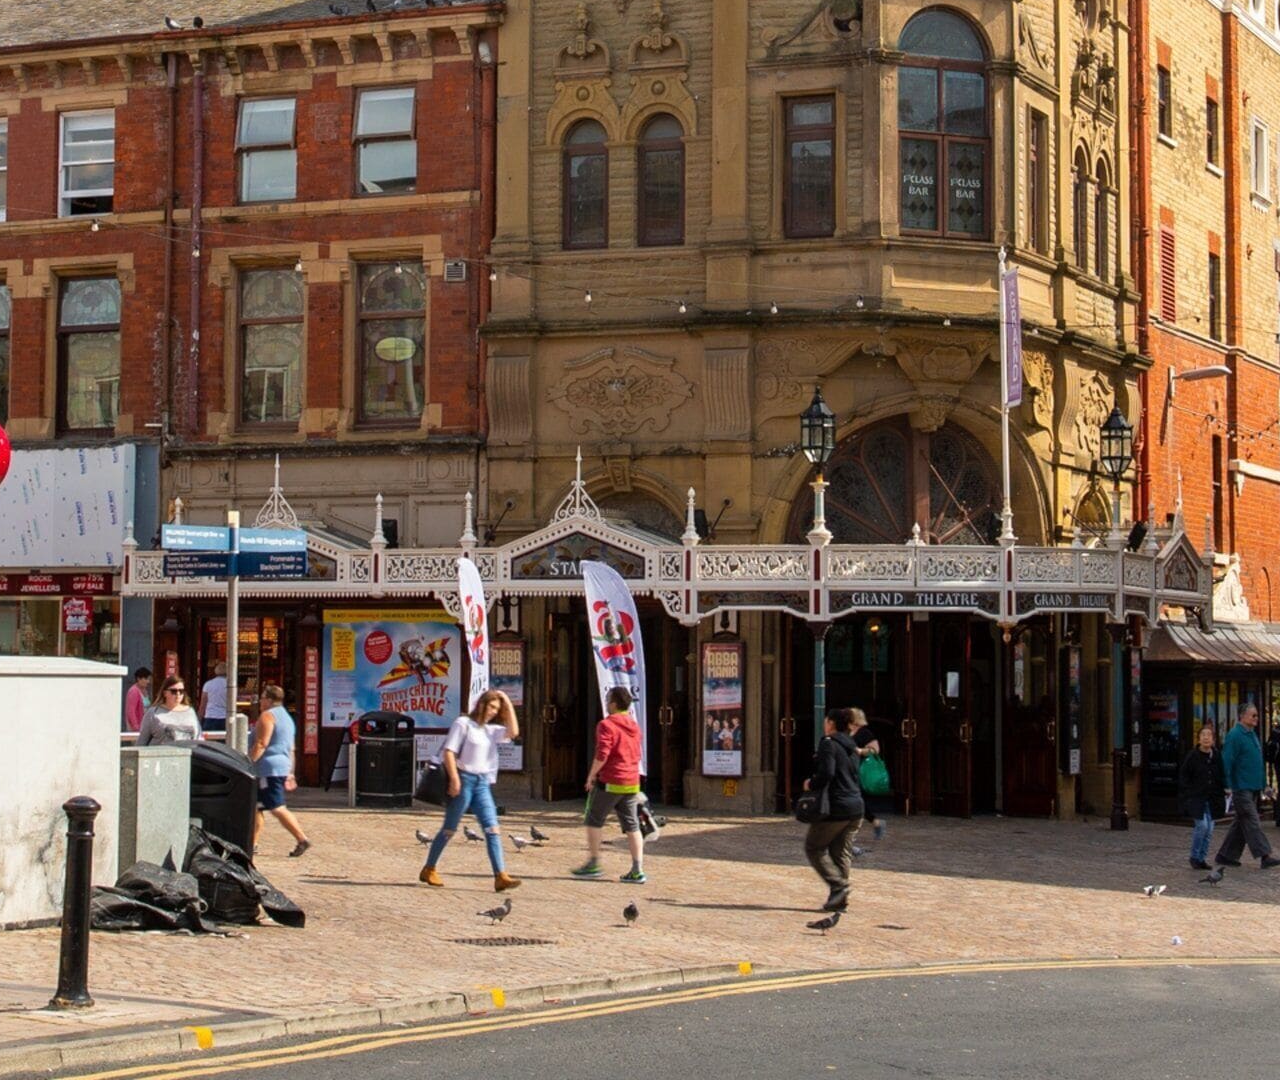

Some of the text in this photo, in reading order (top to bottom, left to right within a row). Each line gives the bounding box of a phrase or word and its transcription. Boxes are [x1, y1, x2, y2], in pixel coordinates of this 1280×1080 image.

[908, 186, 929, 196] BAR
[955, 189, 976, 199] BAR
[20, 584, 61, 592] JEWELLERS
[72, 582, 105, 590] OFF SALE
[851, 592, 980, 606] GRAND THEATRE
[1033, 592, 1072, 606] GRAND
[707, 652, 738, 666] ABBA
[707, 665, 738, 678] MANIA
[381, 681, 449, 701] CHITTY CHITTY
[410, 698, 446, 717] BANG
